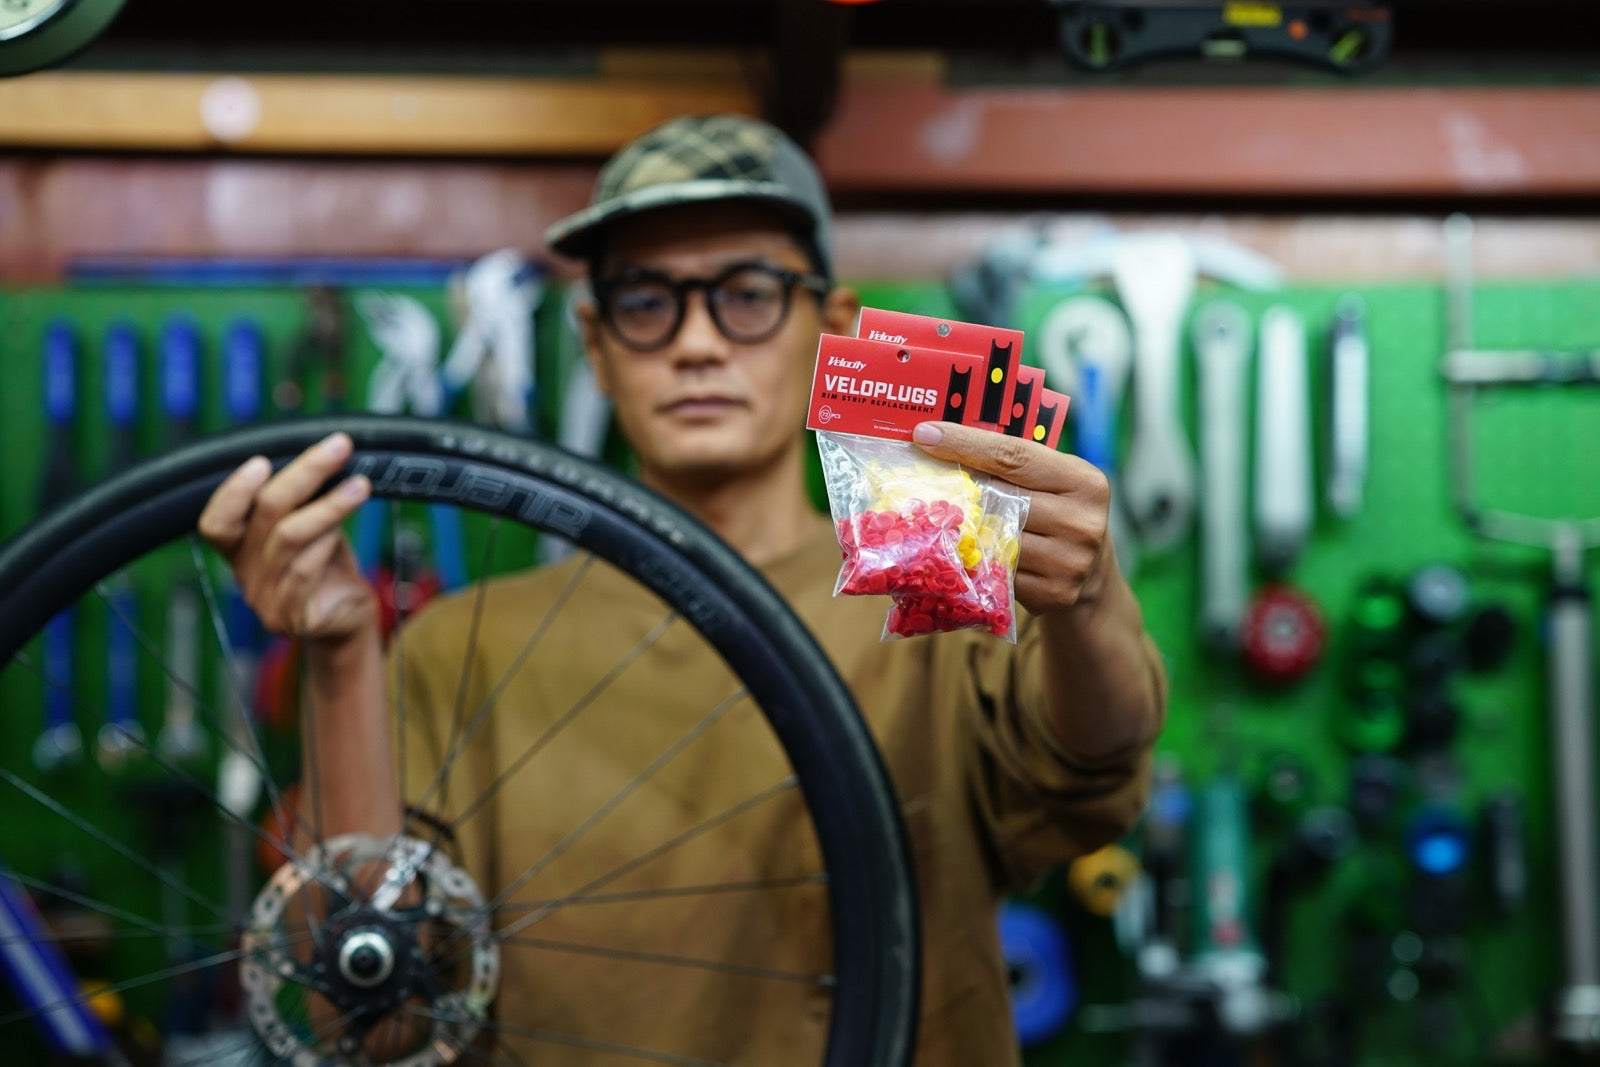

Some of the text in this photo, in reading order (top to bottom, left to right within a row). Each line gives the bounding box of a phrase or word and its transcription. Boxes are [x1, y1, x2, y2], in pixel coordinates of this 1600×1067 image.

[868, 330, 908, 345] Velocity
[827, 356, 867, 372] Velocity
[824, 373, 938, 406] VELOPLUGS
[821, 391, 935, 414] RIM STRIP REPLACEMENT
